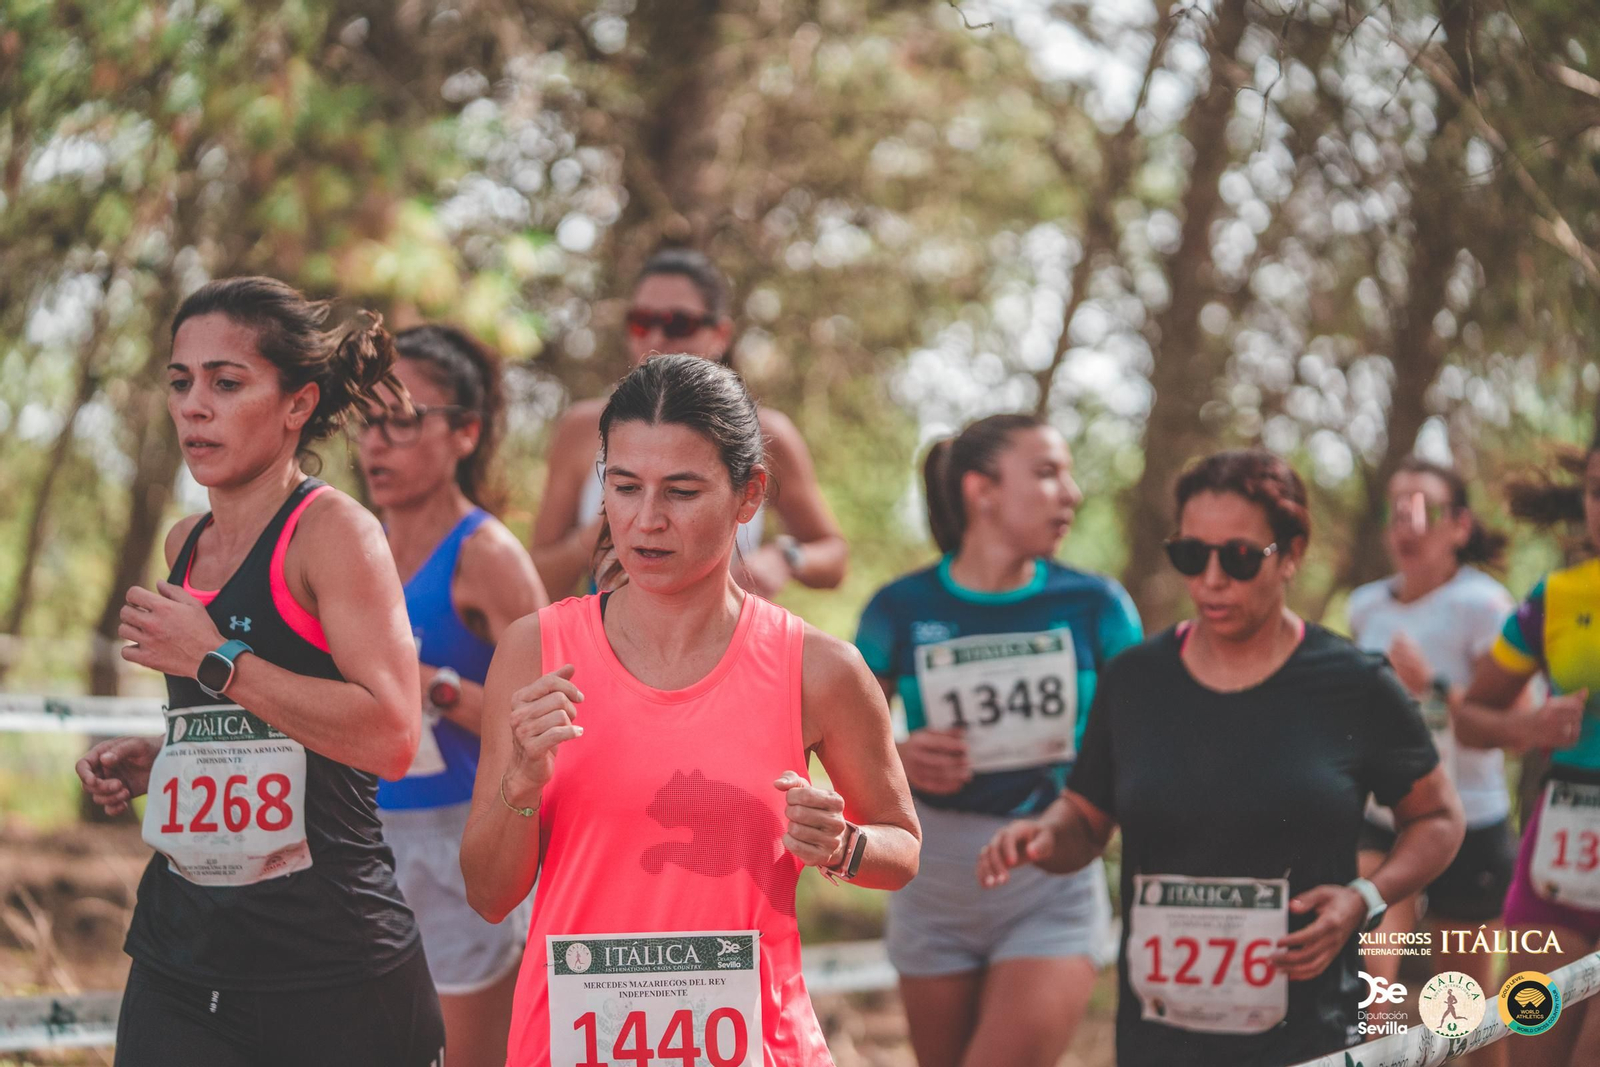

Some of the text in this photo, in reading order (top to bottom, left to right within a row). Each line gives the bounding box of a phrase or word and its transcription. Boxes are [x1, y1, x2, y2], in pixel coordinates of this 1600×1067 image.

[943, 675, 1066, 729] 1348
[161, 773, 293, 833] 1268
[604, 941, 701, 967] ITÁLICA
[717, 961, 741, 969] Sevilla
[1144, 935, 1277, 988] 1276
[583, 977, 726, 990] MERCEDES MAZARIEGOS DEL REY
[619, 989, 688, 998] INDEPENDIENTE
[574, 1007, 748, 1067] 1440
